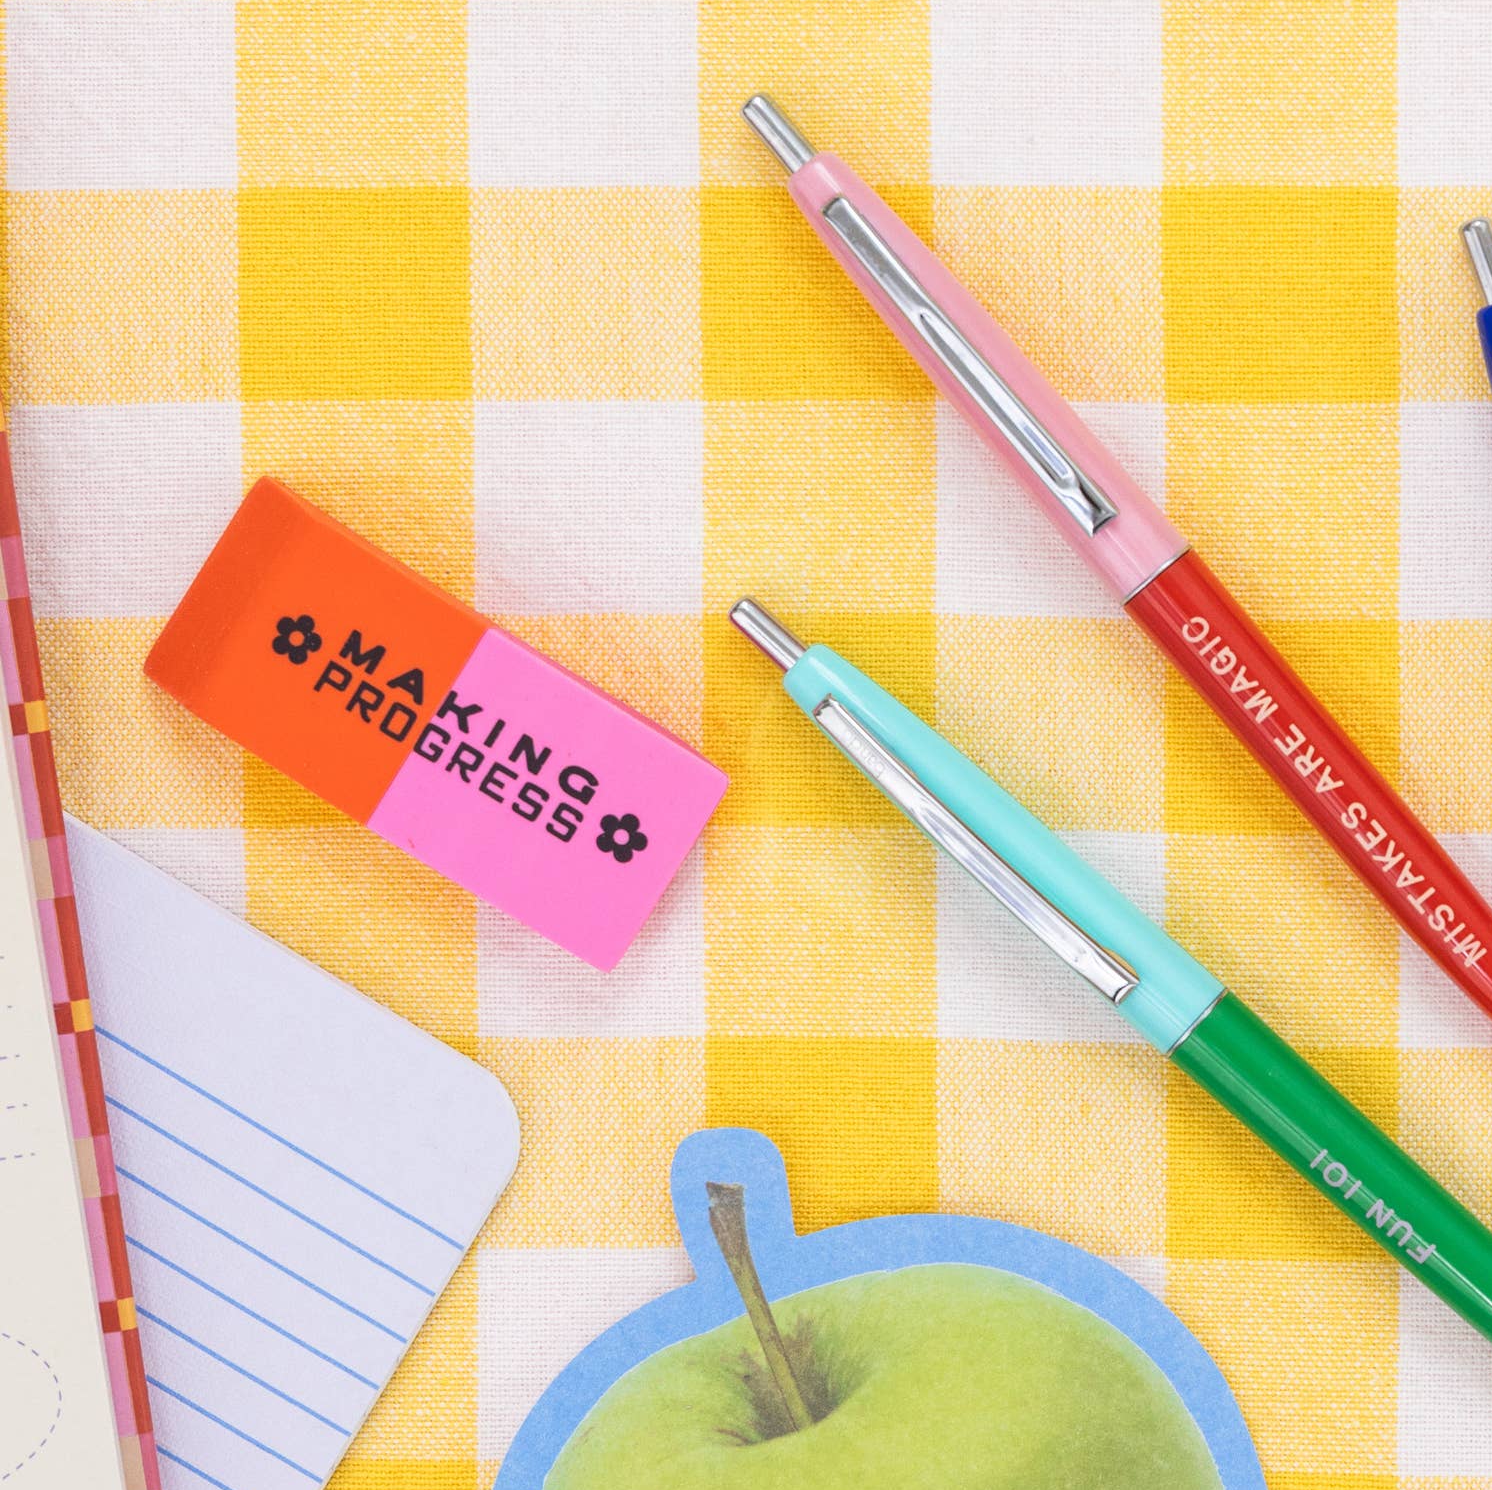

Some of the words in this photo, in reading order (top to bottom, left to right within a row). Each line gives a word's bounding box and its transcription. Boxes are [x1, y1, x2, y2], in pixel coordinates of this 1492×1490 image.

[339, 630, 599, 805] MAKING
[1181, 616, 1279, 723] MAGIC
[314, 661, 583, 842] PROGRESS
[1272, 722, 1345, 795] ARE
[1340, 800, 1489, 969] MISTAKES
[1365, 1198, 1439, 1267] FUN
